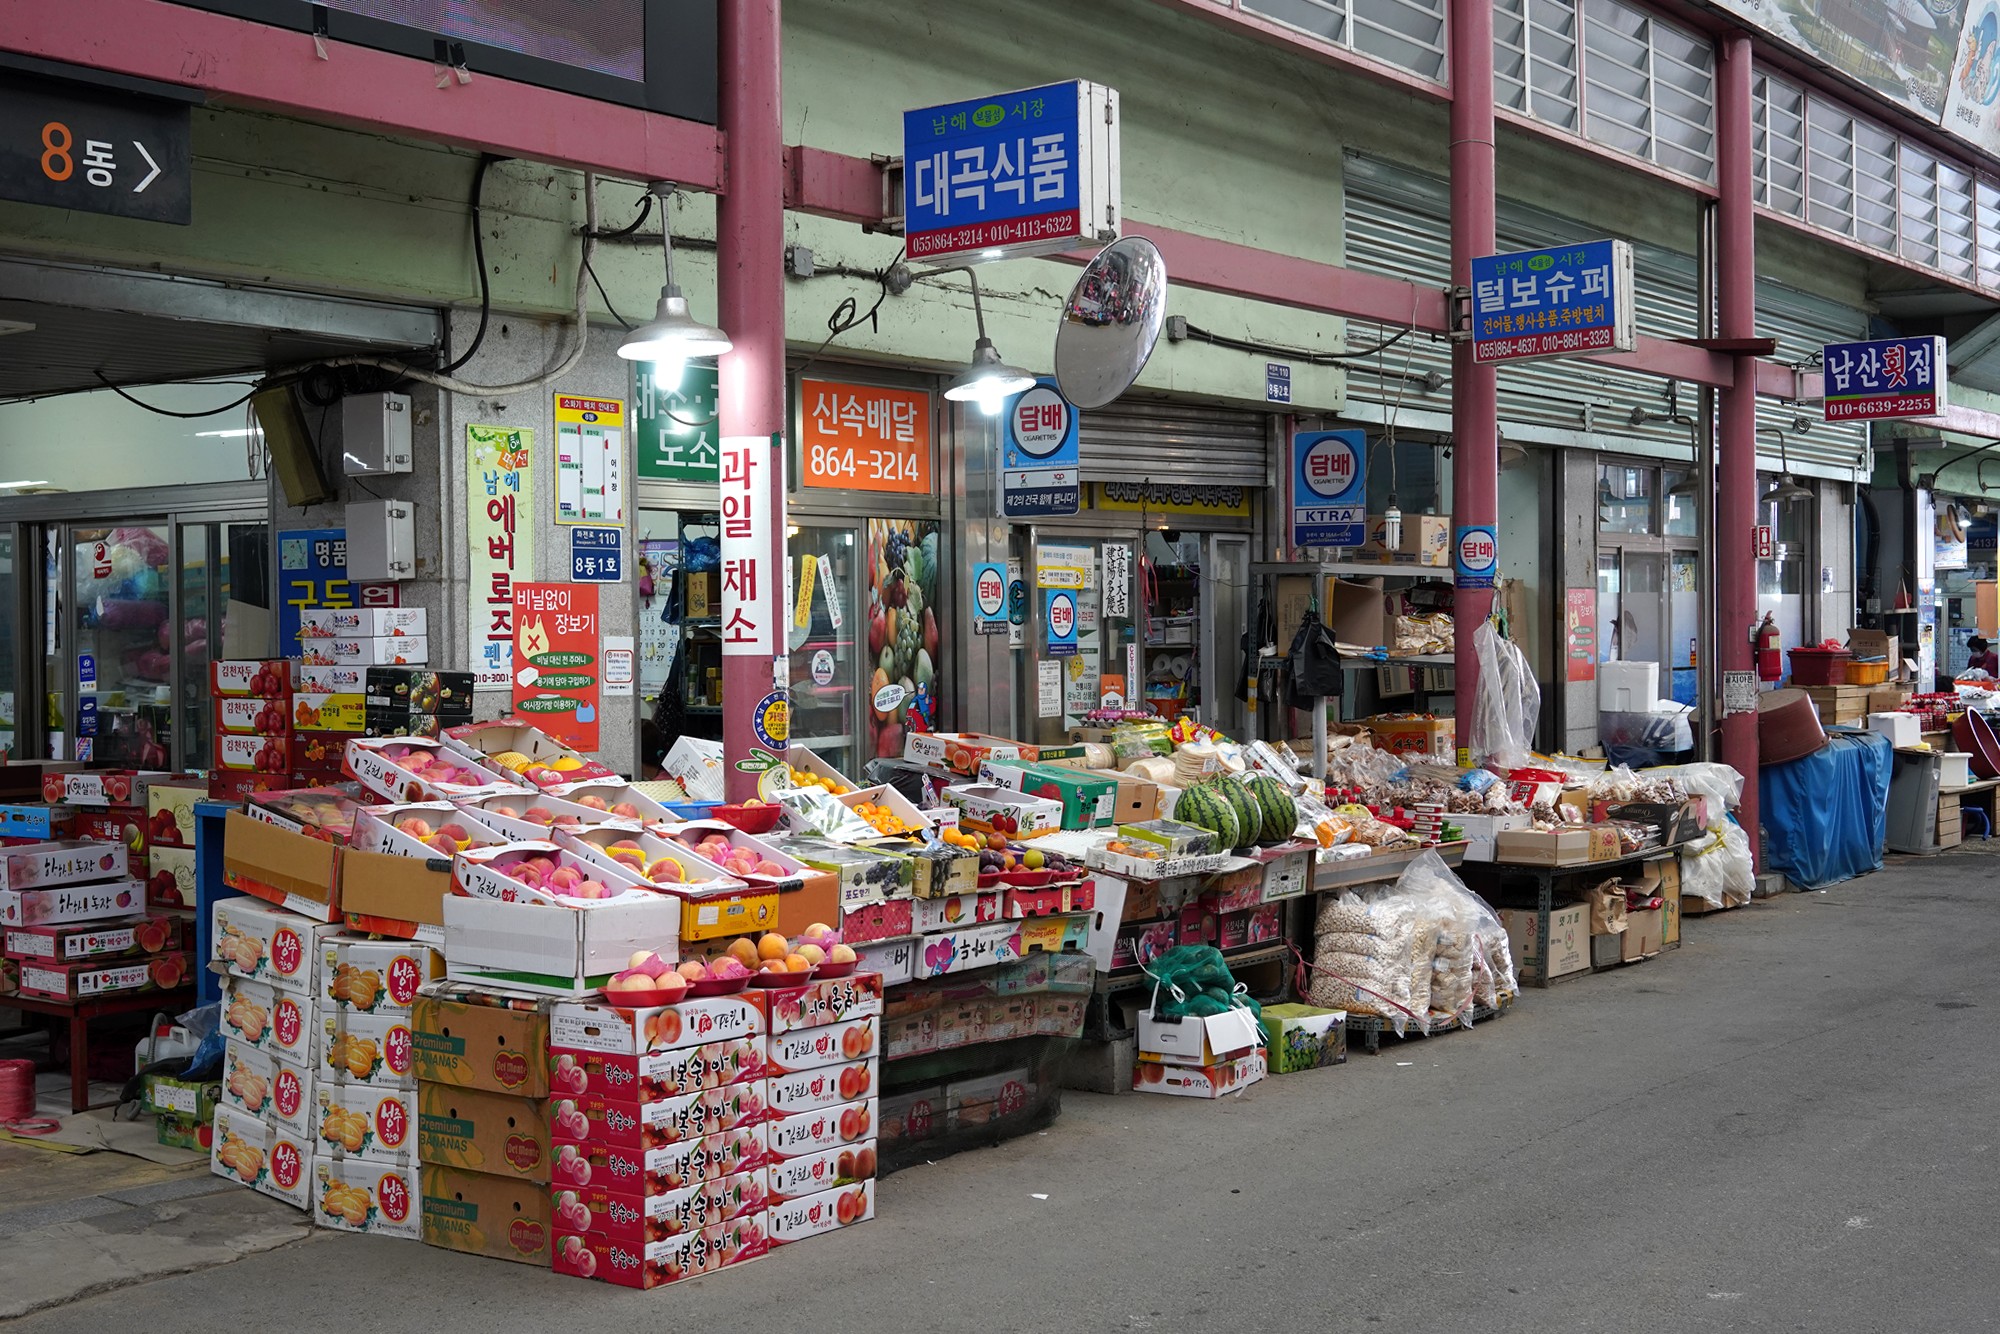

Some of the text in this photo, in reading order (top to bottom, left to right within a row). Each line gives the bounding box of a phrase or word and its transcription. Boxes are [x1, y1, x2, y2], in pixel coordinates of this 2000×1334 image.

[932, 98, 1046, 136] 남해 보물섬 시장
[41, 121, 117, 188] 8동
[915, 133, 1069, 216] 대곡식품
[913, 215, 1073, 252] 055)864-3214 010-4113-6322
[1495, 259, 1523, 276] 남해
[1559, 251, 1587, 267] 시장
[1477, 264, 1610, 314] 털보슈퍼
[1542, 329, 1610, 352] 010-8641-3329
[1829, 343, 1931, 391] 남산횟집
[563, 399, 616, 412] 소화기 배치 안내도
[1829, 398, 1931, 416] 010-6639-2255
[812, 393, 918, 443] 신속배달
[1019, 403, 1062, 432] 담배
[1023, 433, 1057, 442] CIGARETTES
[810, 444, 919, 481] 864-3214
[1310, 453, 1350, 477] 담배
[483, 469, 520, 496] 남해
[1313, 477, 1345, 485] CIGARETTES
[1025, 494, 1039, 506] 건국
[1039, 493, 1052, 505] 함께
[1305, 510, 1352, 522] KTRA
[576, 531, 616, 545] 화전로 110
[722, 447, 758, 644] 과일 채소
[315, 541, 346, 567] 명품
[1462, 541, 1493, 558] 담배
[487, 493, 515, 642] 에버로즈
[979, 581, 1001, 600] 담배
[1116, 546, 1127, 614] 立春大吉
[517, 589, 571, 611] 비닐없이
[555, 614, 594, 635] 장보기
[1052, 606, 1072, 624] 담배
[484, 641, 513, 670] 펜
[536, 655, 549, 665] 비닐
[549, 655, 561, 665] 대신
[569, 655, 587, 665] 주머니
[222, 666, 253, 678] 김천자두
[536, 676, 591, 687] 용기에 담아 구입하기
[1075, 683, 1092, 691] 전통시장
[226, 702, 257, 715] 김천자두
[523, 699, 577, 710] 어시장가방 이용하기
[226, 740, 257, 753] 김천자두
[913, 741, 931, 756] 햇살
[1393, 739, 1425, 750] 새우깡
[363, 759, 383, 780] 김천
[72, 782, 89, 796] 햇살
[26, 815, 46, 825] 복숭아
[103, 820, 121, 840] 멜론
[75, 860, 95, 874] 농장
[476, 875, 500, 898] 김천
[845, 886, 870, 899] 포도향기
[91, 895, 112, 910] 농장
[1559, 912, 1580, 927] 엿기름
[107, 935, 130, 946] 복숭아
[277, 933, 298, 961] 성주
[121, 973, 145, 983] 복숭아
[393, 960, 415, 991] 성주
[809, 981, 853, 1018] 복숭아
[279, 1005, 298, 1033] 성주
[390, 1031, 412, 1060] 성주
[414, 1035, 452, 1051] Premium
[789, 1042, 814, 1061] 김천
[413, 1052, 458, 1069] BANANAS
[496, 1061, 528, 1075] Del Monte
[605, 1063, 634, 1085] 복숭아
[676, 1053, 730, 1092] 복숭아
[279, 1074, 298, 1103] 성주
[784, 1082, 809, 1102] 김천
[1002, 1085, 1023, 1112] 성주
[381, 1104, 402, 1131] 성주
[420, 1117, 461, 1134] Premium
[607, 1109, 636, 1132] 복숭아
[679, 1100, 731, 1139] 복숭아
[420, 1135, 467, 1152] BANANAS
[786, 1126, 810, 1146] 김천
[276, 1146, 297, 1175] 성주
[507, 1144, 540, 1157] Del Monte
[609, 1154, 639, 1177] 복숭아
[680, 1145, 731, 1184] 복숭아
[787, 1166, 811, 1187] 김천
[383, 1178, 404, 1207] 성주
[425, 1200, 465, 1215] Premium
[609, 1201, 639, 1224] 복숭아
[681, 1190, 732, 1230] 복숭아
[425, 1215, 470, 1235] BANANAS
[783, 1211, 808, 1231] 김천
[511, 1229, 544, 1242] Del Monte
[609, 1247, 639, 1269] 복숭아
[681, 1231, 732, 1274] 복숭아
